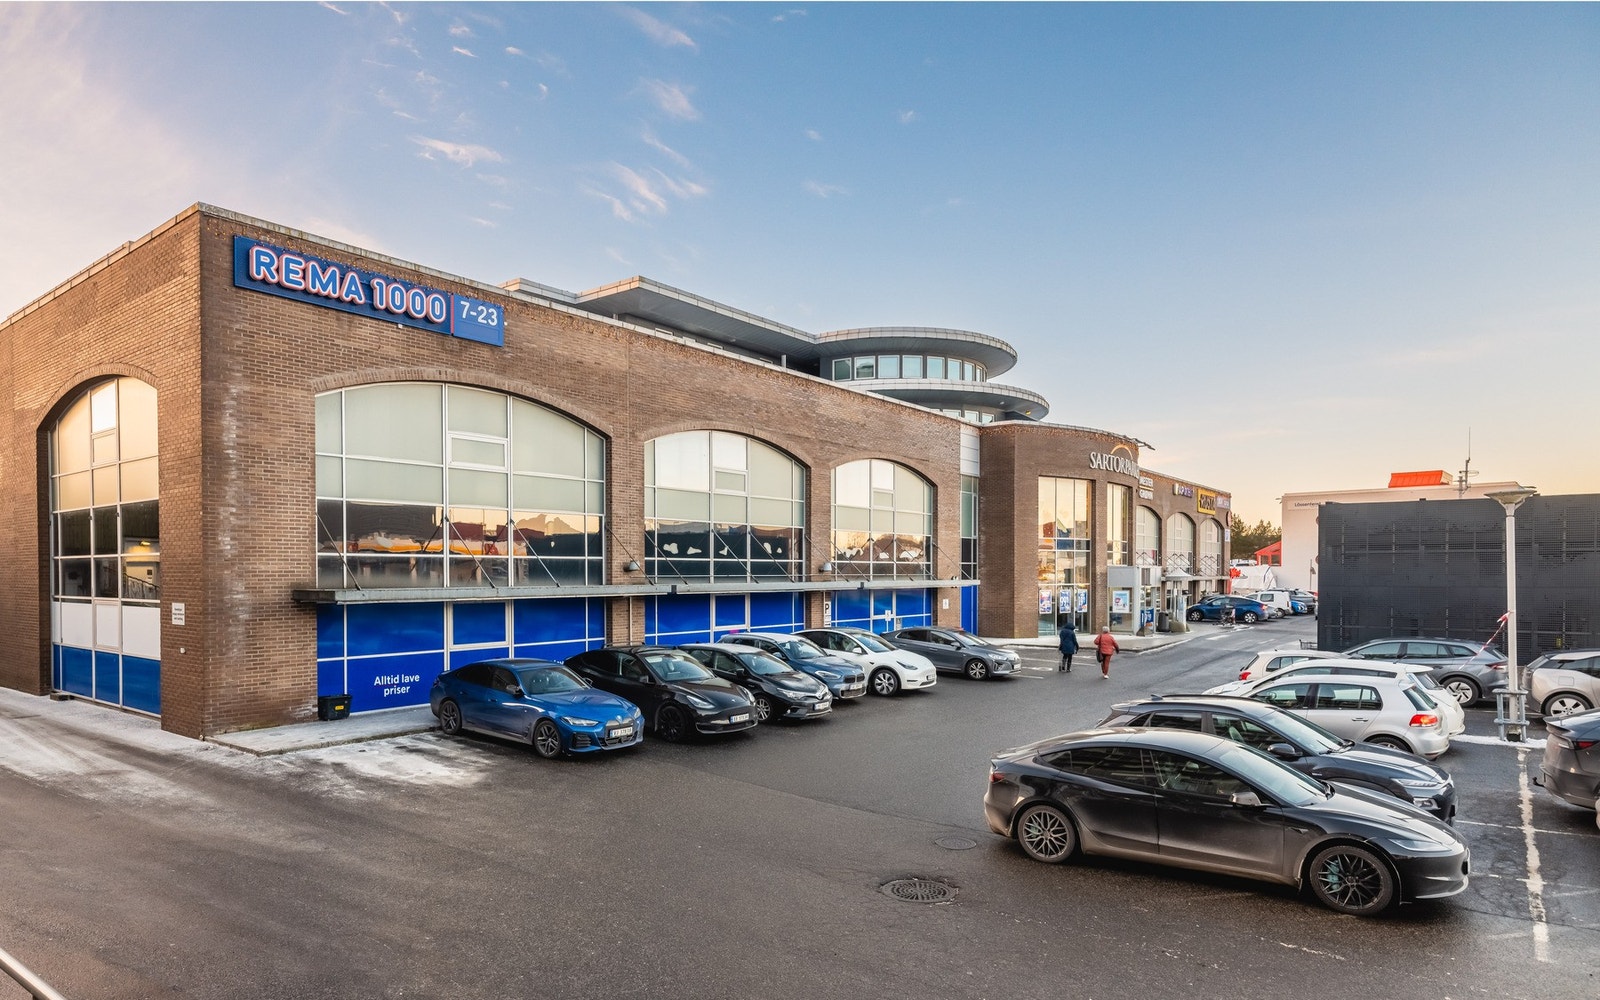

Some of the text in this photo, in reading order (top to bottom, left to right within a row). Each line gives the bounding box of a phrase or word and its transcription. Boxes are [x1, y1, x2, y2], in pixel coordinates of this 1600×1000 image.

[249, 245, 446, 324] REMA 1000
[460, 300, 498, 326] 7-23
[374, 674, 420, 686] Alltid lave
[384, 685, 411, 697] priser
